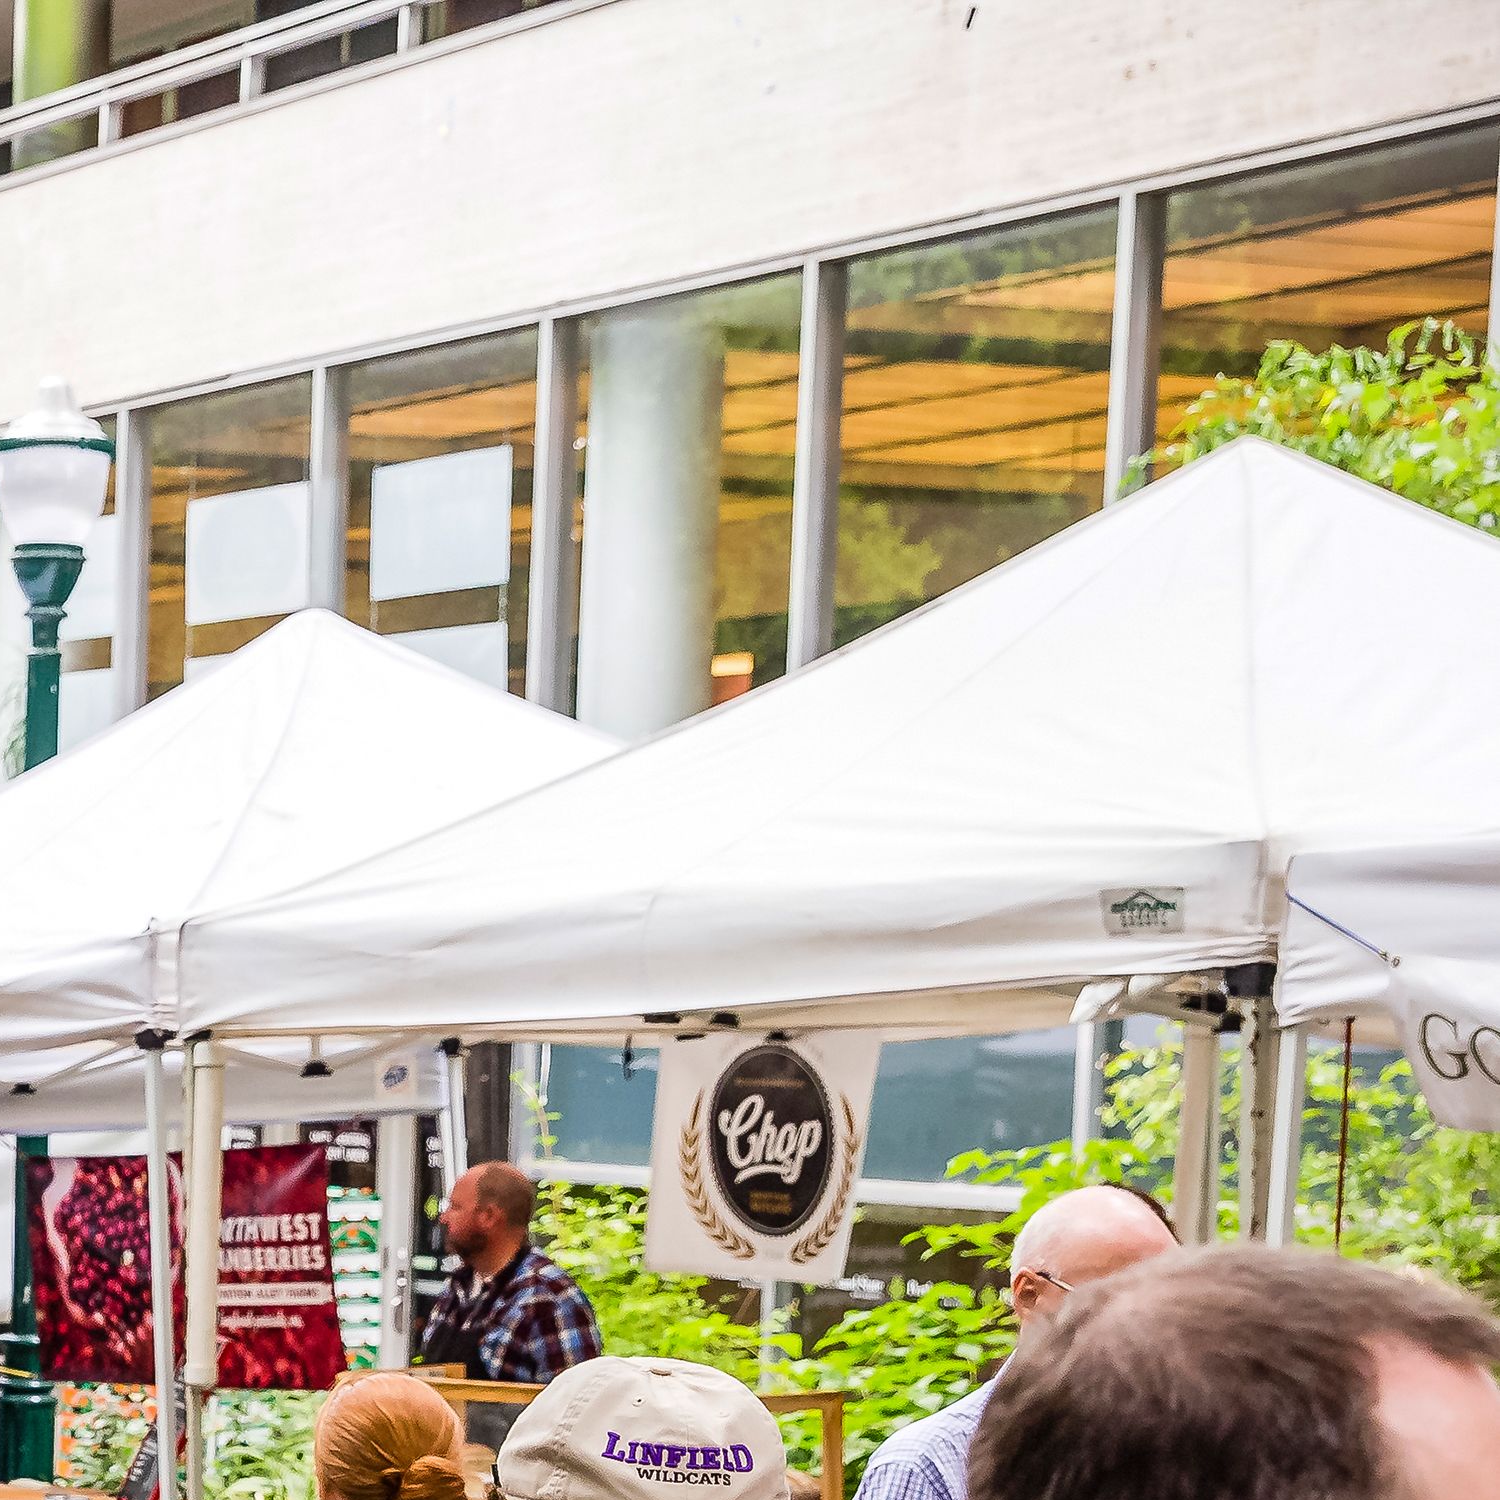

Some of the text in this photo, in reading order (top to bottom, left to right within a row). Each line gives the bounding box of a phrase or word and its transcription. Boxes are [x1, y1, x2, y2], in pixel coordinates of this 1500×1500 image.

[718, 1093, 822, 1185] Chop
[601, 1431, 754, 1473] LINFIELD
[636, 1467, 731, 1486] WILDCATS
